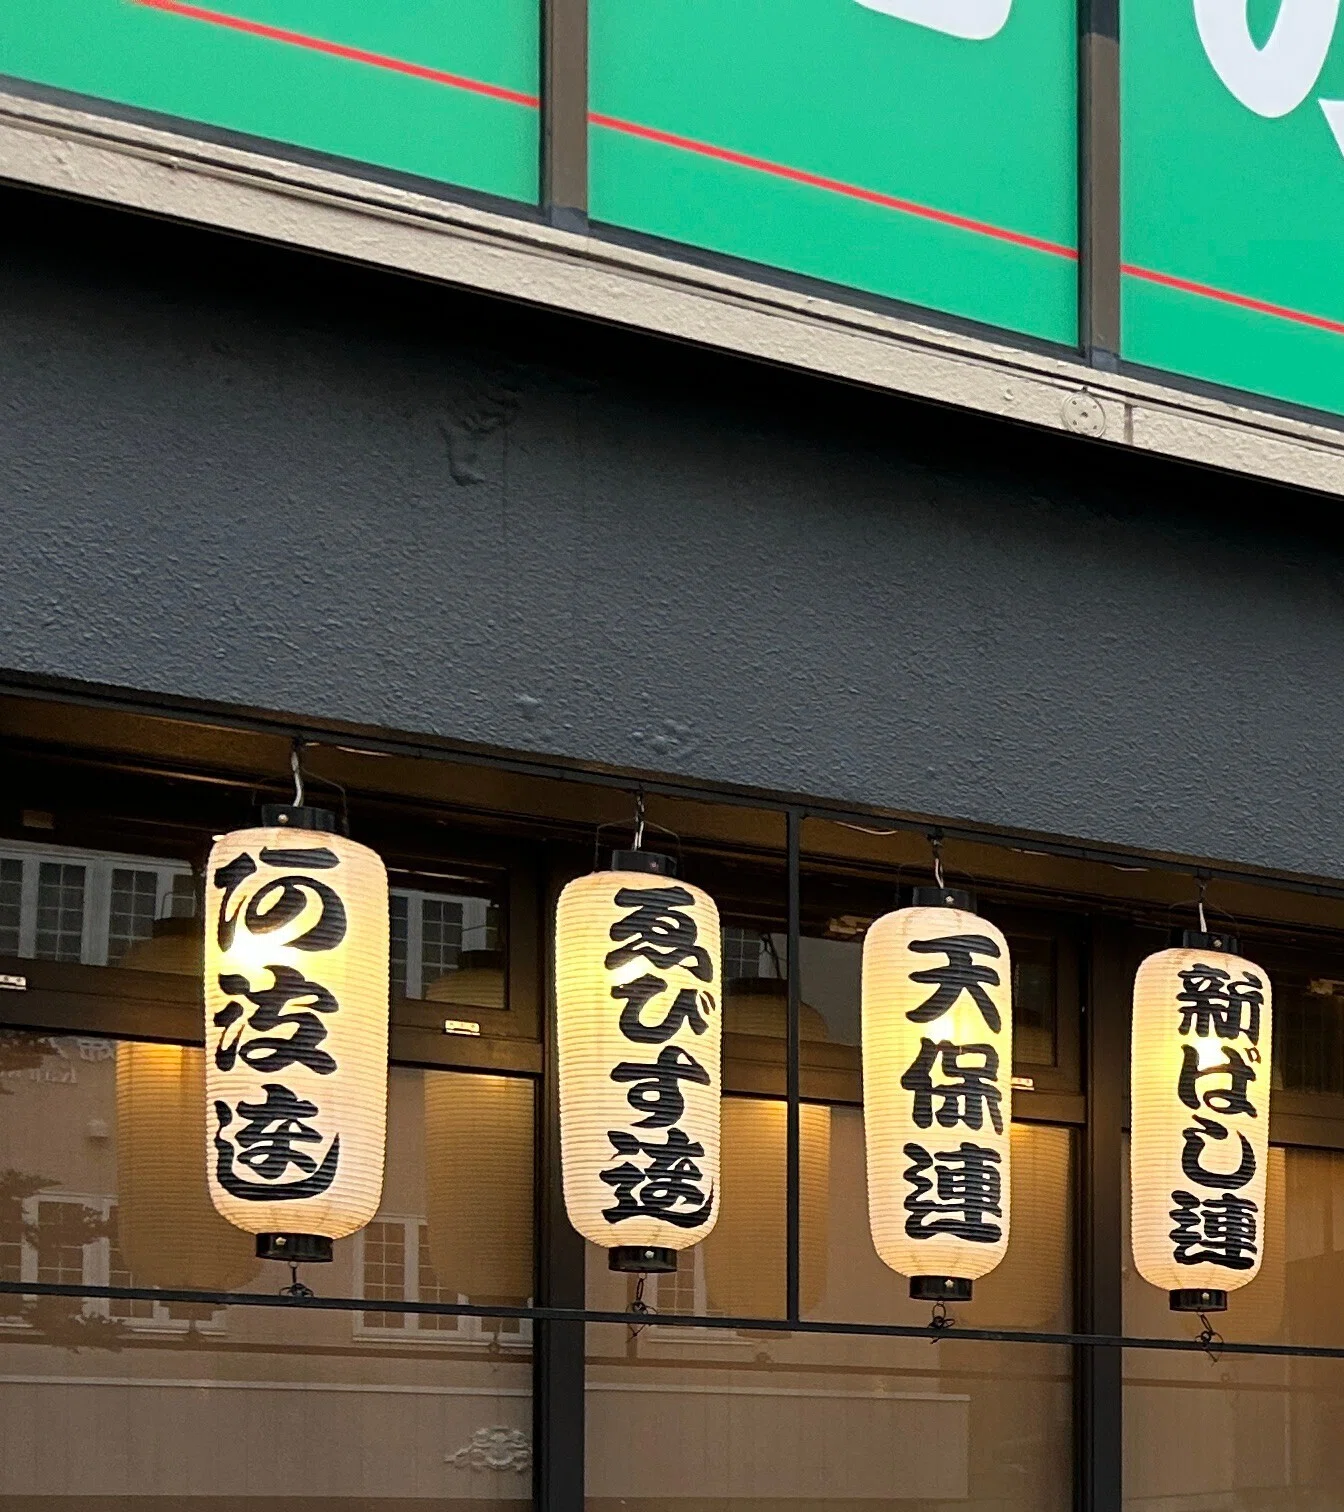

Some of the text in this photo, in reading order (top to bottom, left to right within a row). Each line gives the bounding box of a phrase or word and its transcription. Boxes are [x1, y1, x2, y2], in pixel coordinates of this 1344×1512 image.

[901, 934, 1004, 1244] 天保連
[1169, 963, 1265, 1270] 新ばし連
